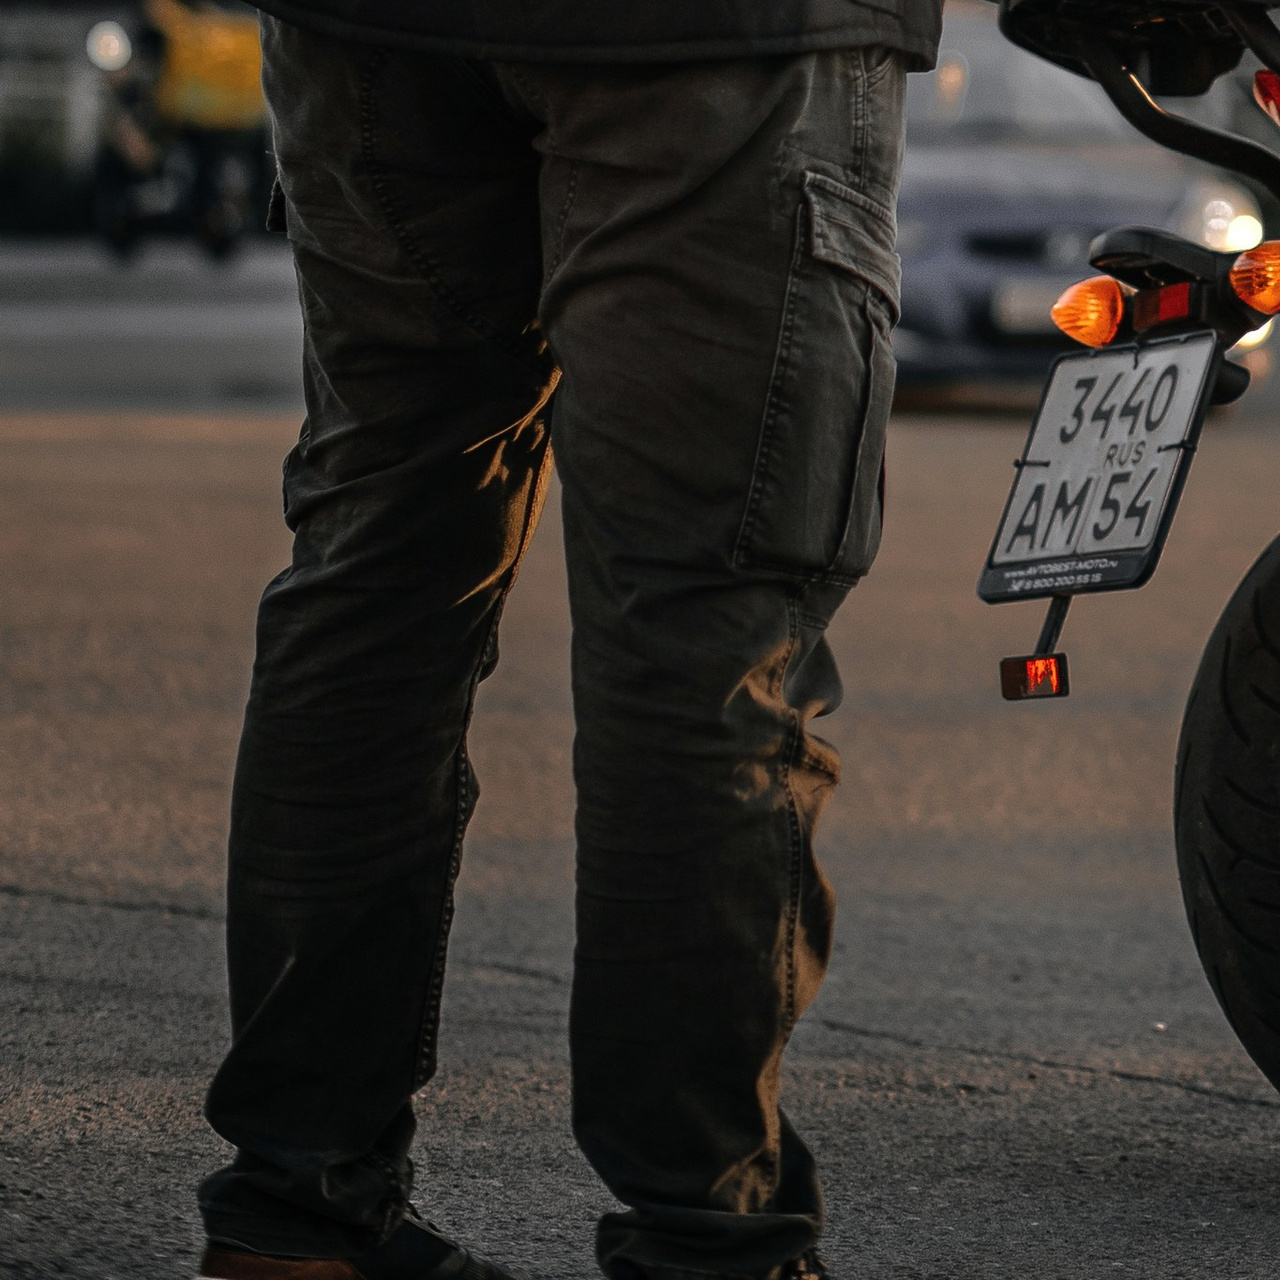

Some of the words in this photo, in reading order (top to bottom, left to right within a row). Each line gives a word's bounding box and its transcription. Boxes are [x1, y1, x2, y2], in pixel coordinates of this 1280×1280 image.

[1060, 363, 1179, 444] 3440
[1104, 440, 1147, 469] RUS
[1092, 466, 1159, 541] 54
